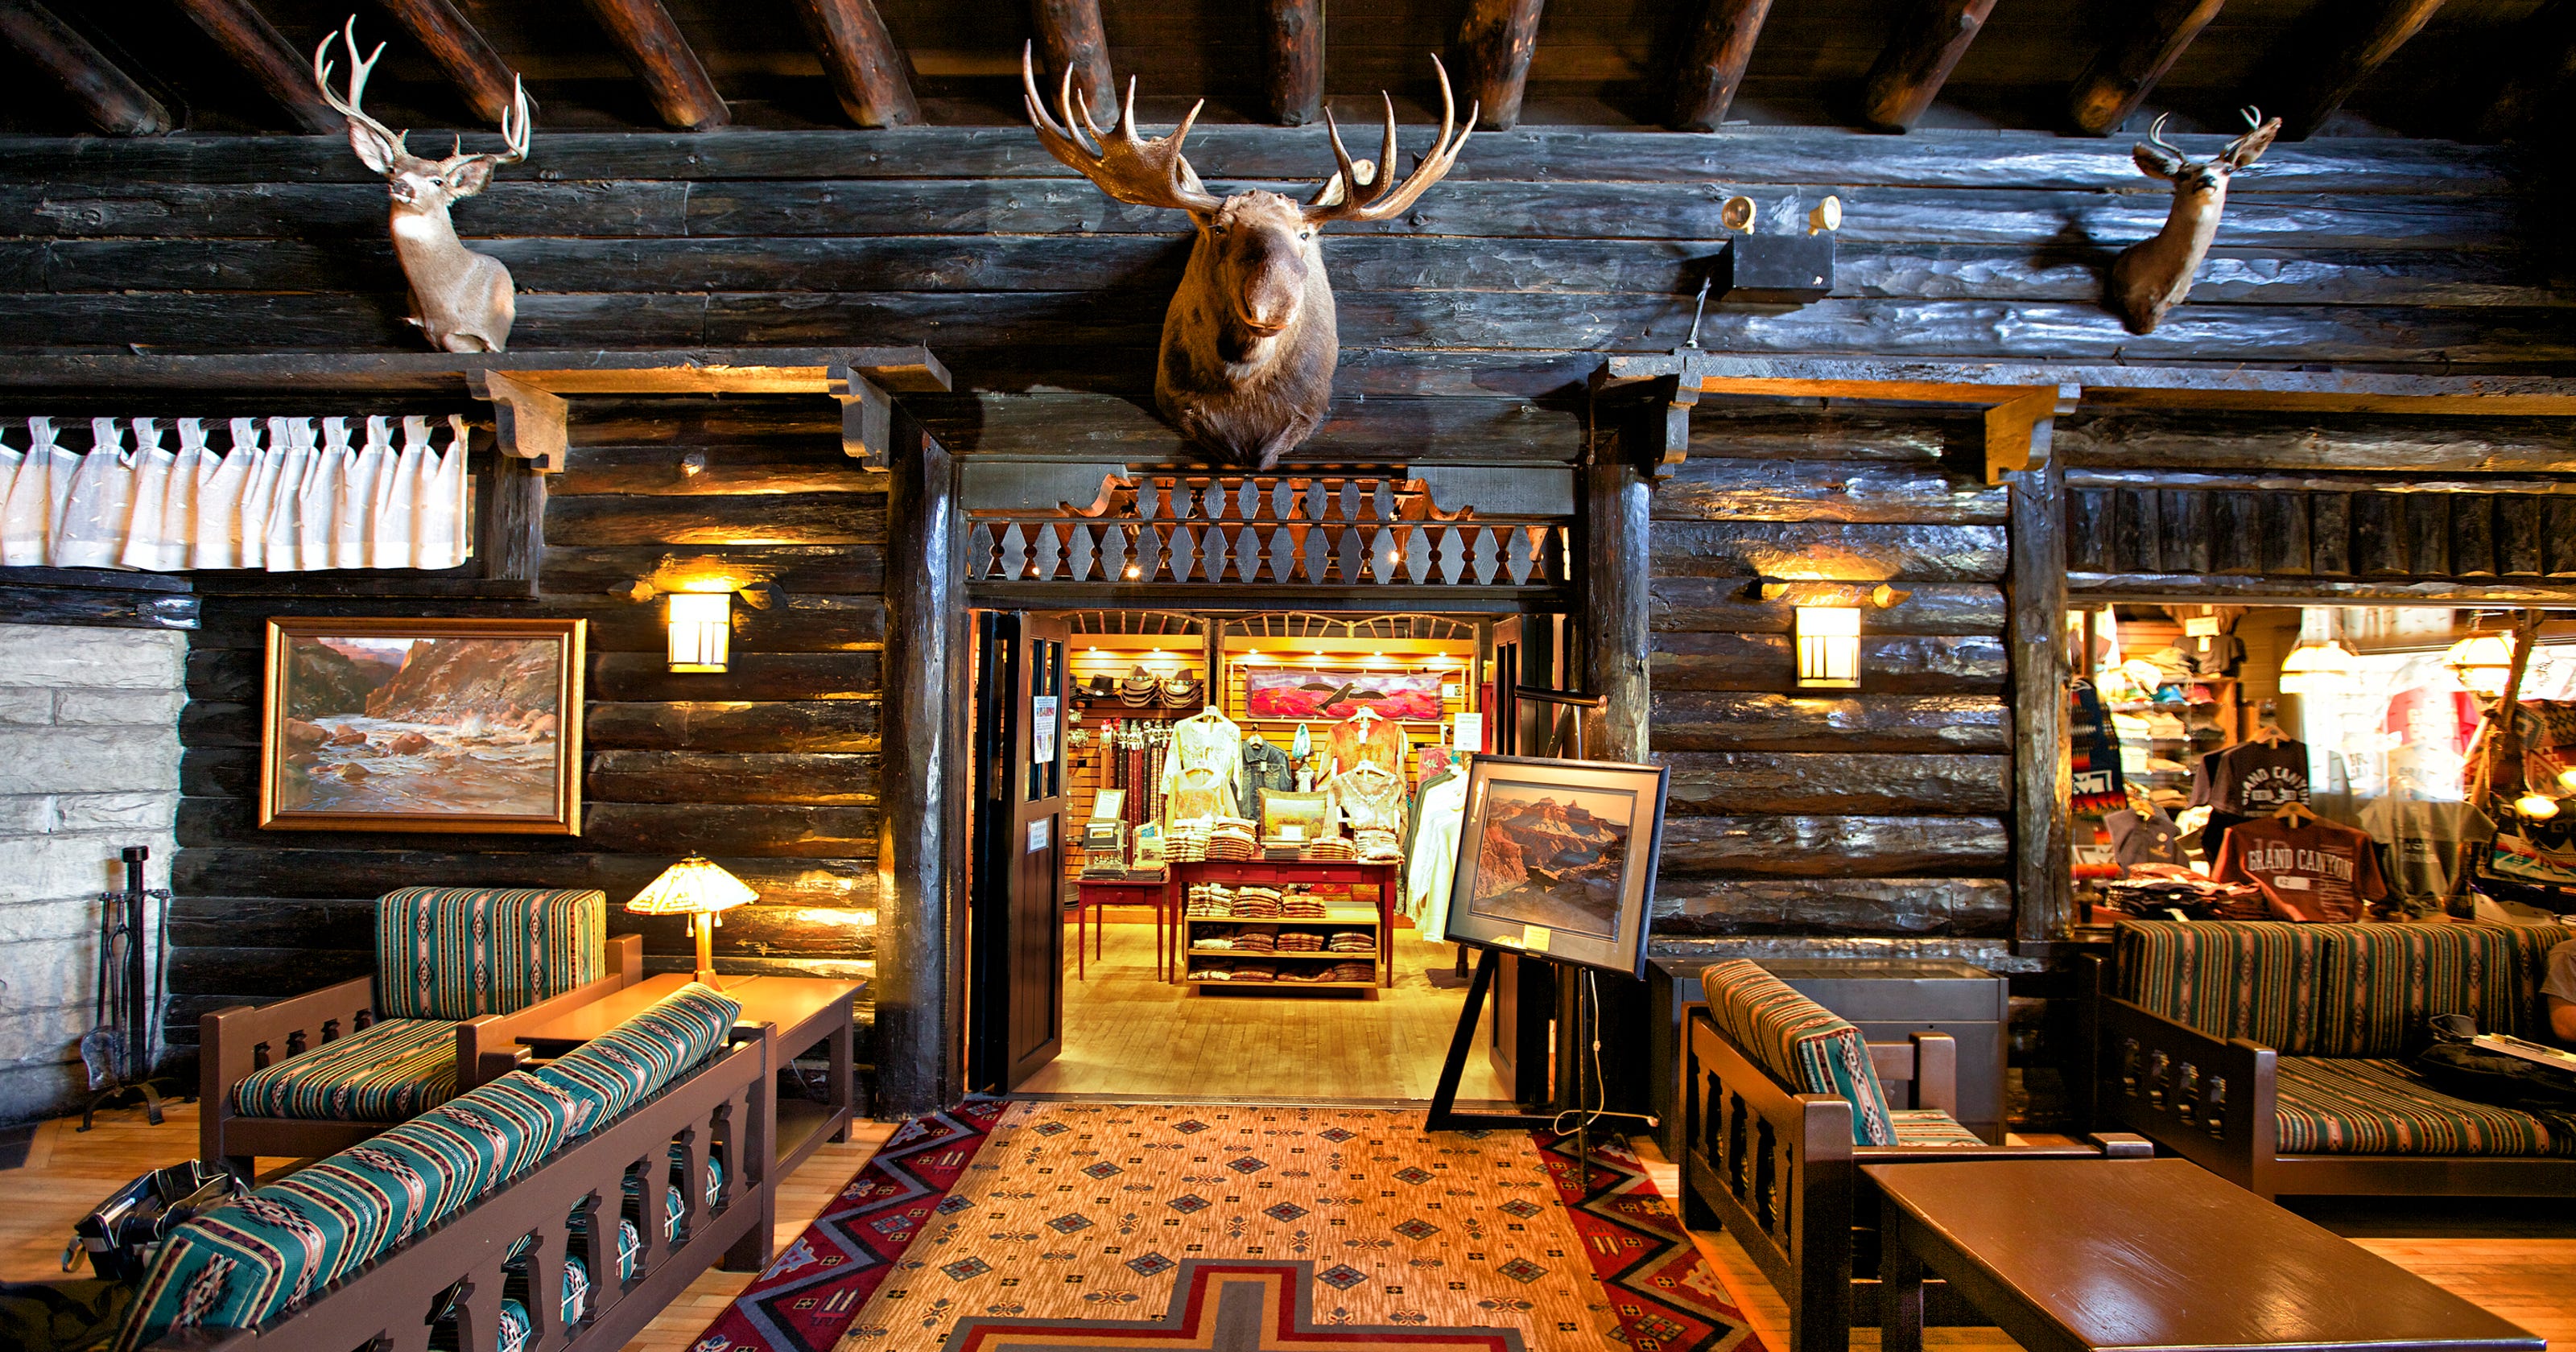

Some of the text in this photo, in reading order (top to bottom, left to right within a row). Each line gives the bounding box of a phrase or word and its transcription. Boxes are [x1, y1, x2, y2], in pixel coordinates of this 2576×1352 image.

[2242, 766, 2310, 806] GRAND CANYON
[2248, 849, 2354, 882] GRAND CANYON
